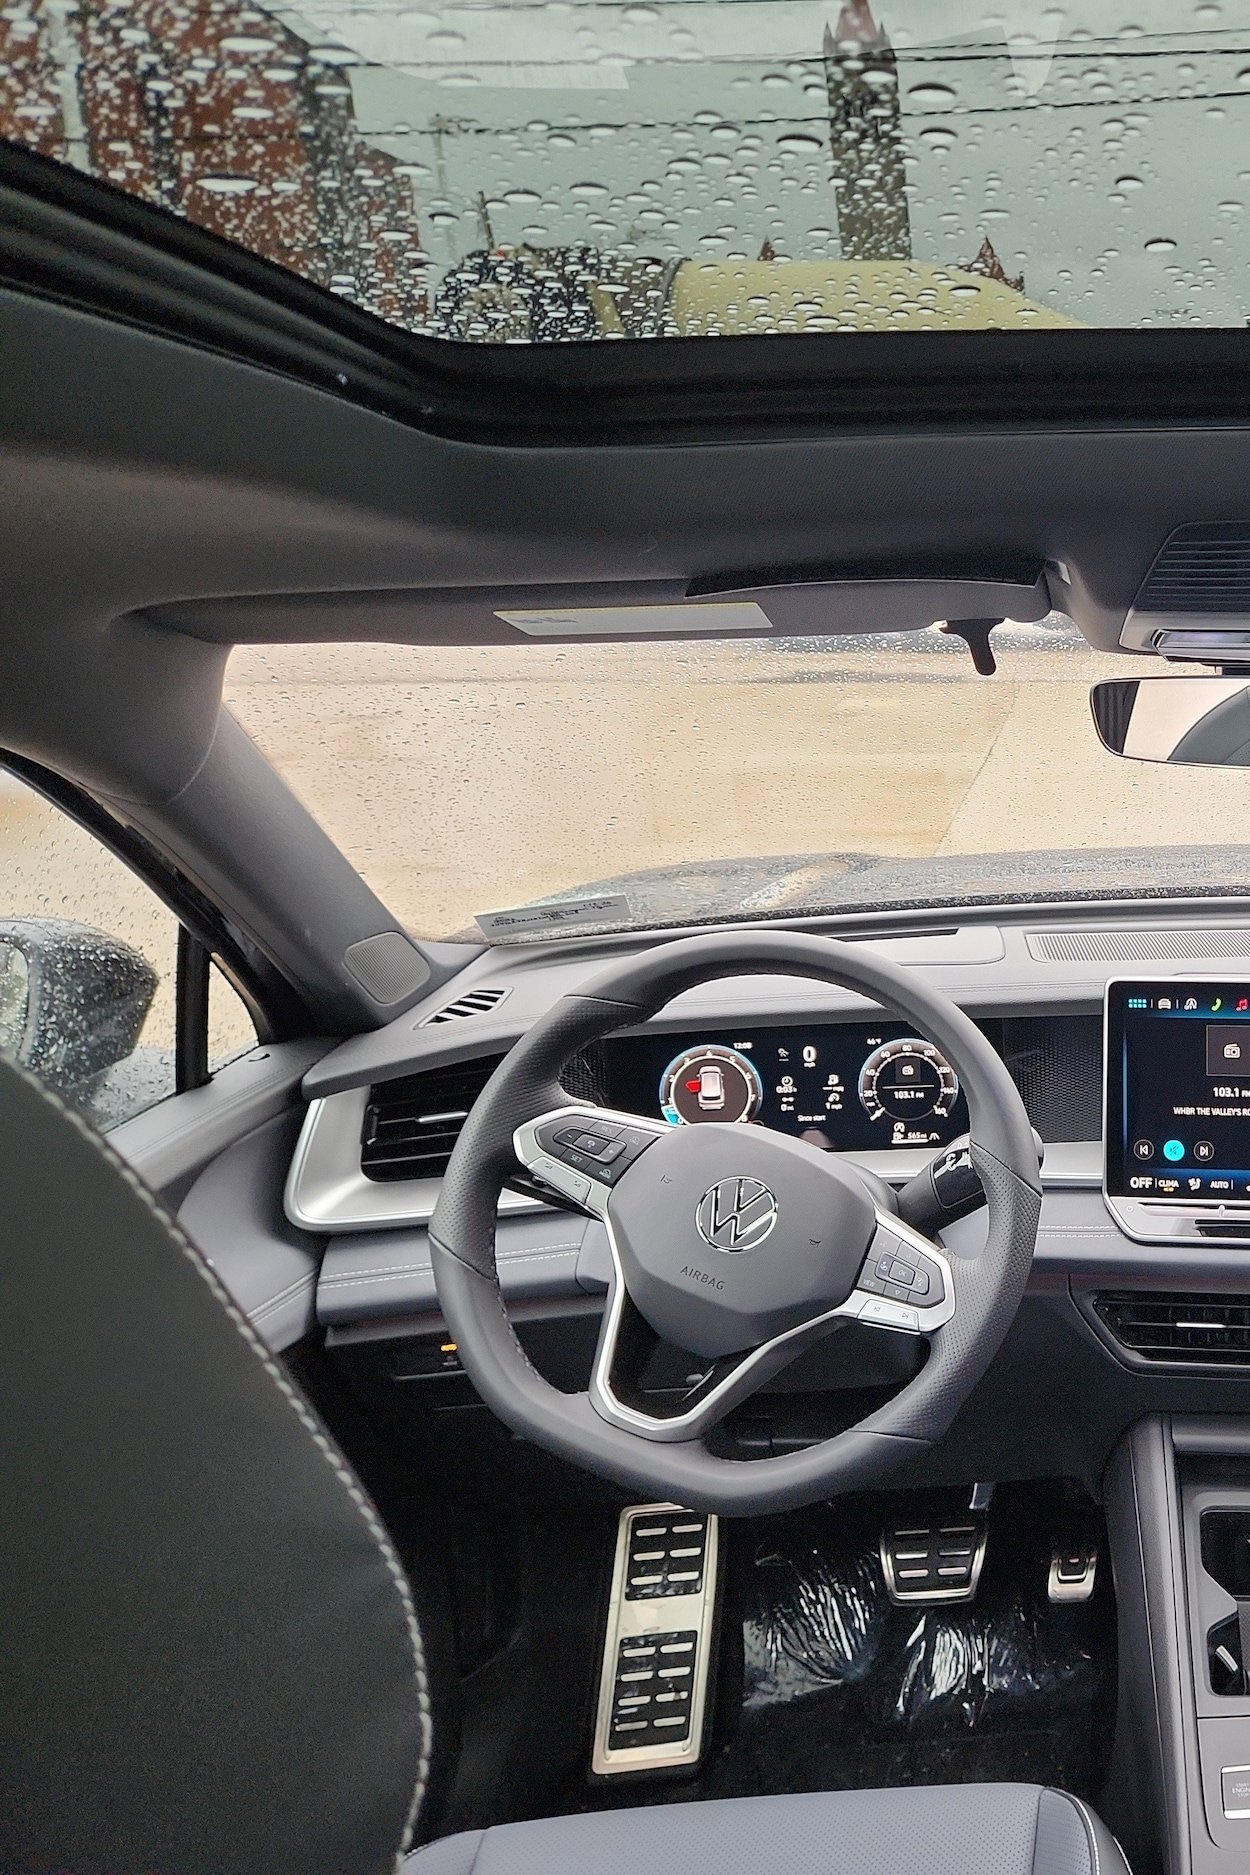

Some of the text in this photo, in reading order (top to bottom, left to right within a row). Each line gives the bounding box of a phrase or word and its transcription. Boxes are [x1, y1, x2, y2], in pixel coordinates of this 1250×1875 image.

[803, 1046, 816, 1062] 0
[894, 1091, 915, 1099] 103.1
[1213, 1087, 1240, 1097] 103.1
[1196, 1107, 1210, 1116] THE
[1211, 1107, 1241, 1116] VALLEY'S
[571, 1154, 583, 1164] SET
[1130, 1177, 1152, 1189] OFF
[1158, 1180, 1179, 1188] CLIMA
[1210, 1181, 1229, 1189] AUTO
[680, 1266, 725, 1291] AIRBAG
